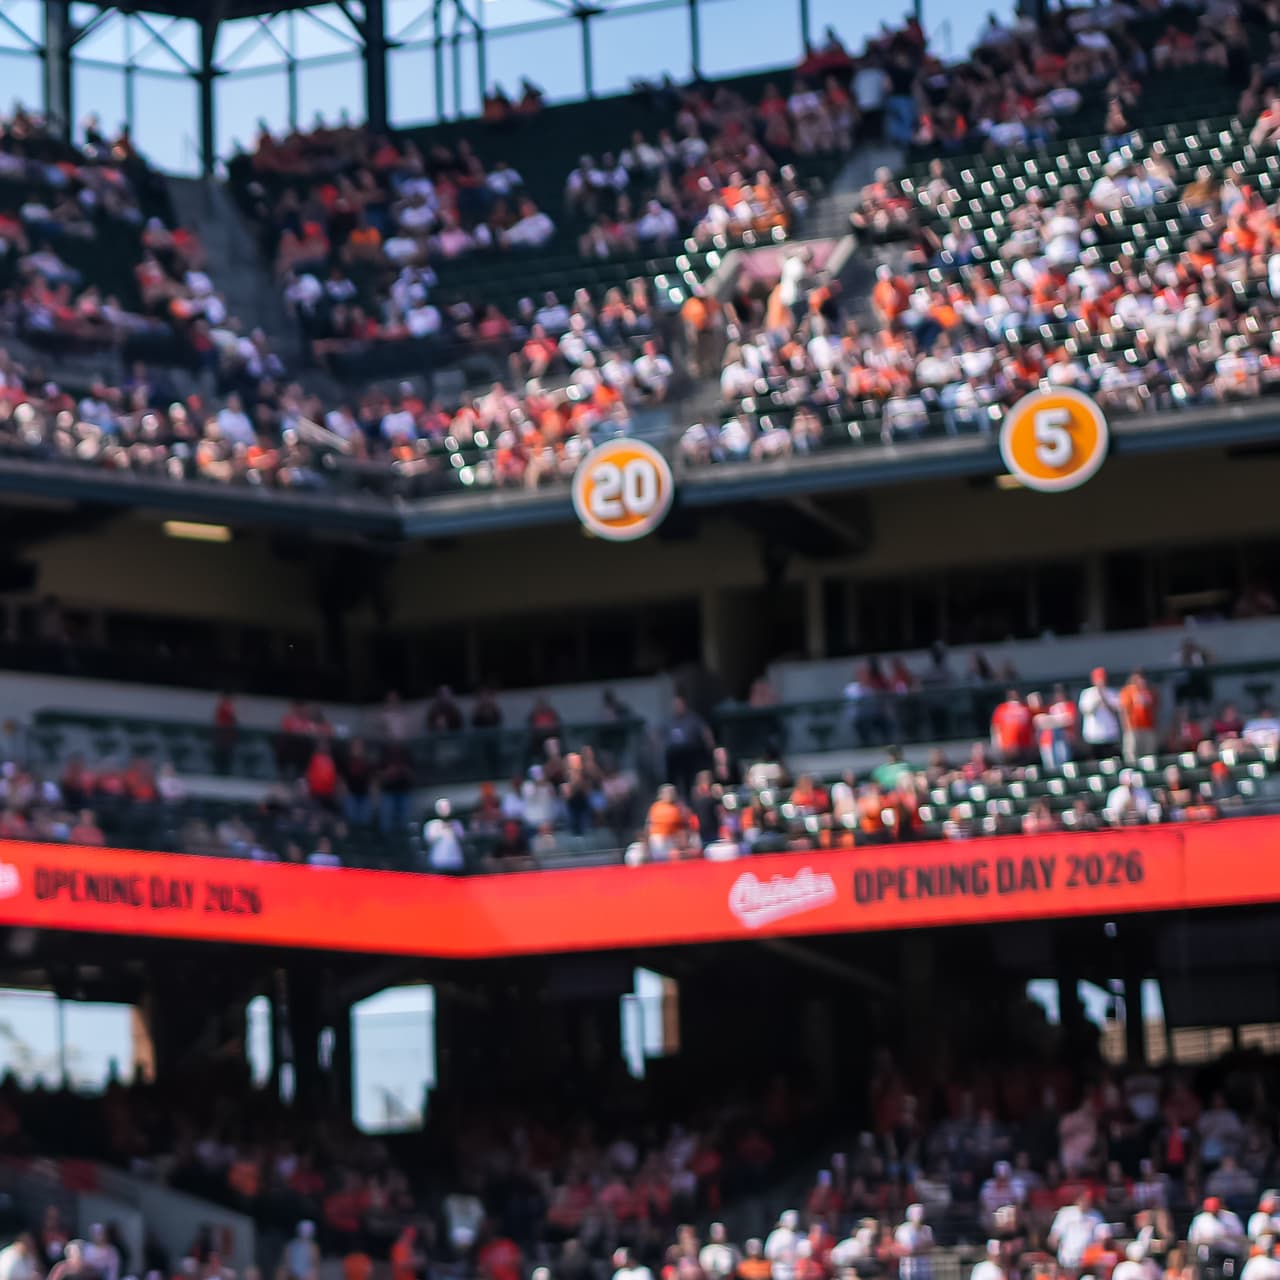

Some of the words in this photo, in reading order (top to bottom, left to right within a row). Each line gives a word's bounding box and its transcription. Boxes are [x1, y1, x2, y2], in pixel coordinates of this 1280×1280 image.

[1034, 408, 1074, 467] 5
[591, 458, 657, 519] 20
[33, 866, 143, 907] OPENING
[149, 875, 194, 910] DAY
[203, 880, 263, 915] 2026
[853, 862, 990, 905] OPENING
[996, 855, 1057, 895] DAY
[1065, 850, 1145, 888] 2026
